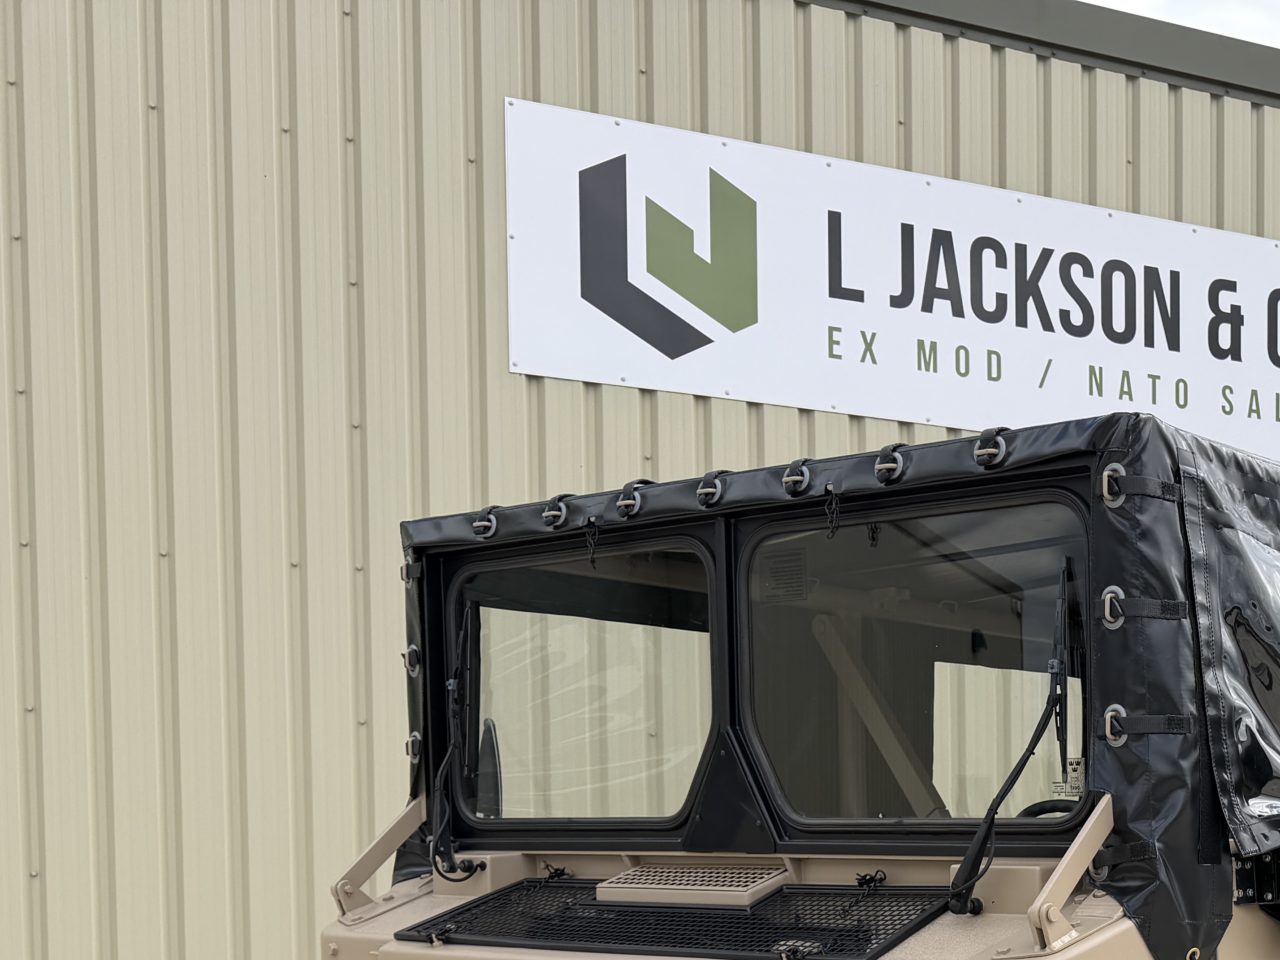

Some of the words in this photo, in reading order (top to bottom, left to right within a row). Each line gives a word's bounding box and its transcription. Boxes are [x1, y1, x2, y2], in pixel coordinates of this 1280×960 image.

[827, 209, 865, 304] L
[889, 222, 1181, 353] JACKSON
[1207, 278, 1245, 363] &
[827, 325, 878, 365] EX
[916, 338, 1002, 382] MOD
[1038, 358, 1053, 389] /
[1088, 364, 1189, 410] NATO
